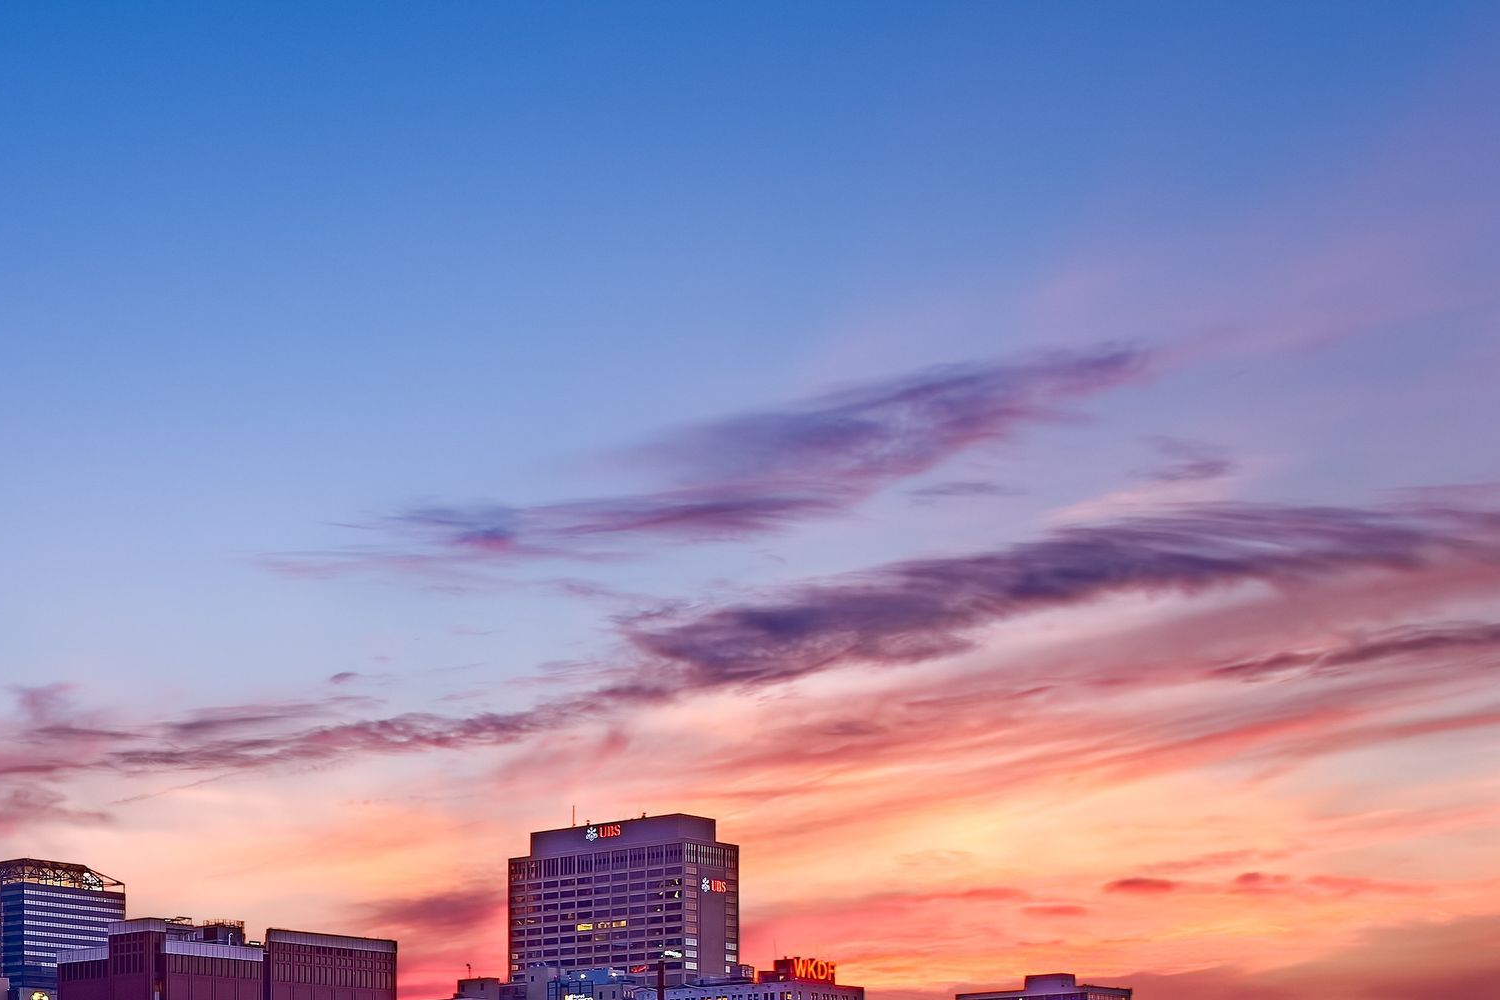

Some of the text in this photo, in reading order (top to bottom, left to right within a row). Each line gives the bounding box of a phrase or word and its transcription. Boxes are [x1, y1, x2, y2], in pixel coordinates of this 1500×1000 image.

[599, 824, 621, 838] UBS
[711, 879, 727, 893] UBS
[793, 958, 837, 981] WKDF
